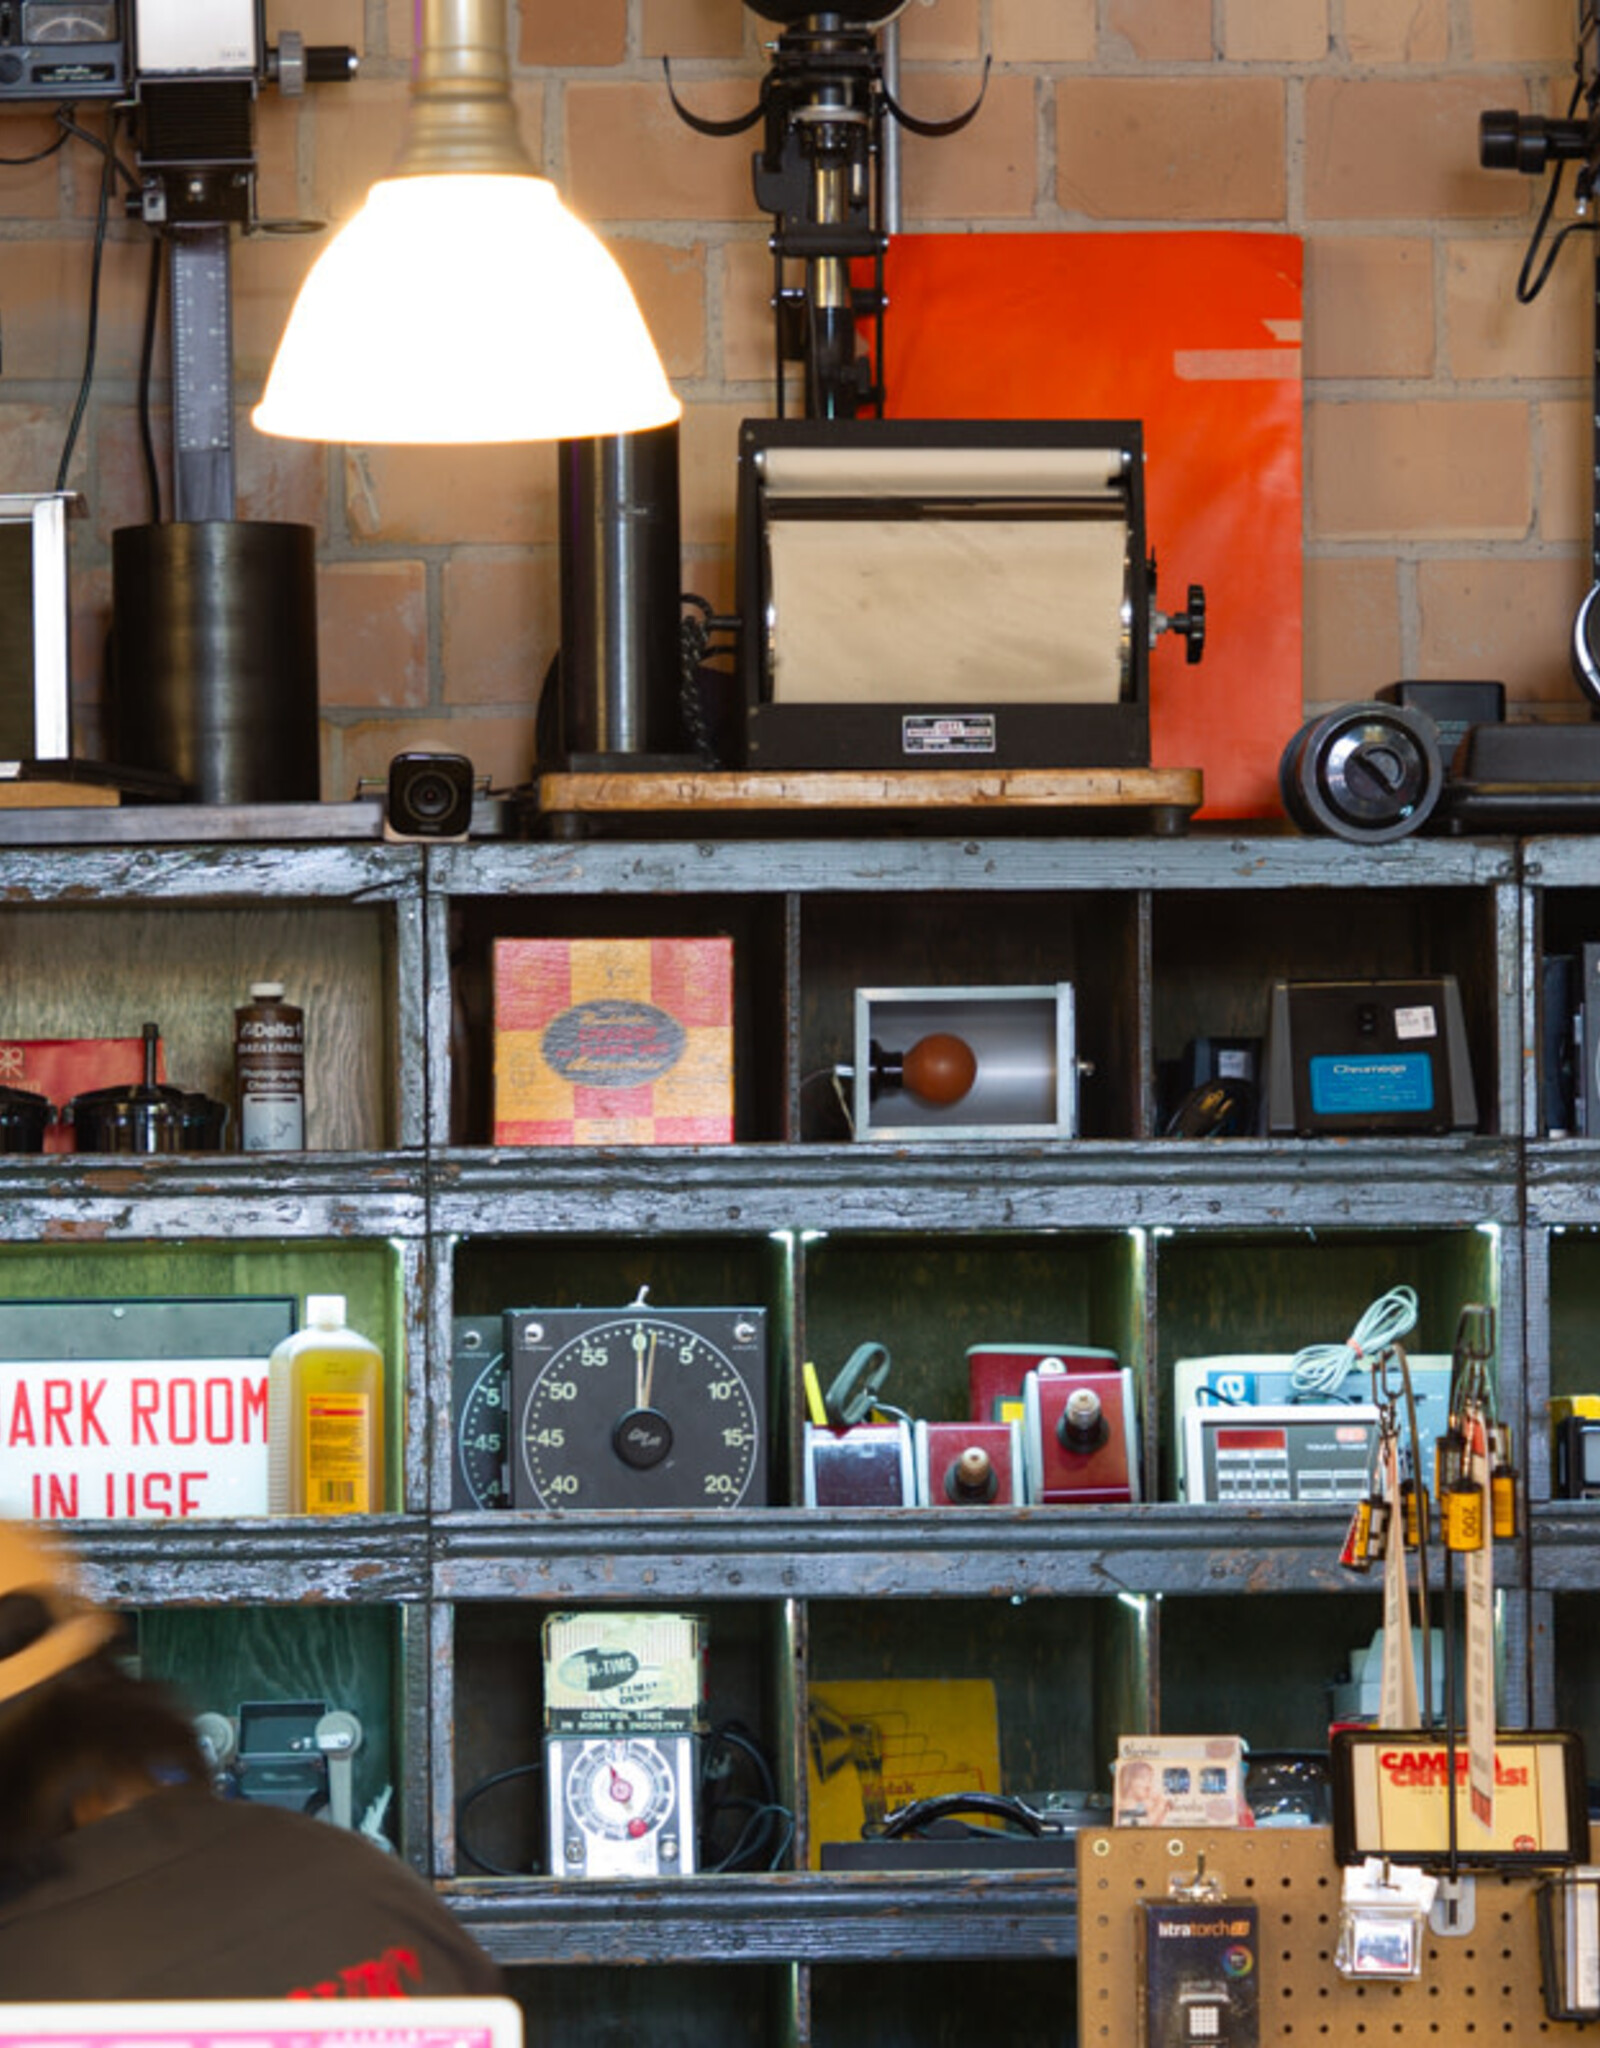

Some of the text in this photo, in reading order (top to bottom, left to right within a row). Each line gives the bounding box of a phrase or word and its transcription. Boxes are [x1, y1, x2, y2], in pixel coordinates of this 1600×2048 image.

[252, 1022, 294, 1038] Delta
[581, 1348, 608, 1366] 55
[679, 1346, 694, 1365] 5
[485, 1387, 501, 1406] 5
[549, 1382, 577, 1400] 50
[707, 1382, 732, 1400] 10
[7, 1376, 268, 1448] ARK ROOM
[475, 1432, 501, 1452] 45
[537, 1428, 565, 1447] 45
[721, 1429, 744, 1448] 15
[486, 1480, 501, 1497] 4
[550, 1475, 578, 1494] 40
[704, 1475, 732, 1494] 20
[32, 1473, 78, 1518] IN
[1460, 1504, 1478, 1539] 200
[581, 1710, 665, 1721] CONTROL TIME
[561, 1721, 574, 1731] IN
[578, 1721, 611, 1731] HOME
[629, 1721, 685, 1731] INDUSTRY
